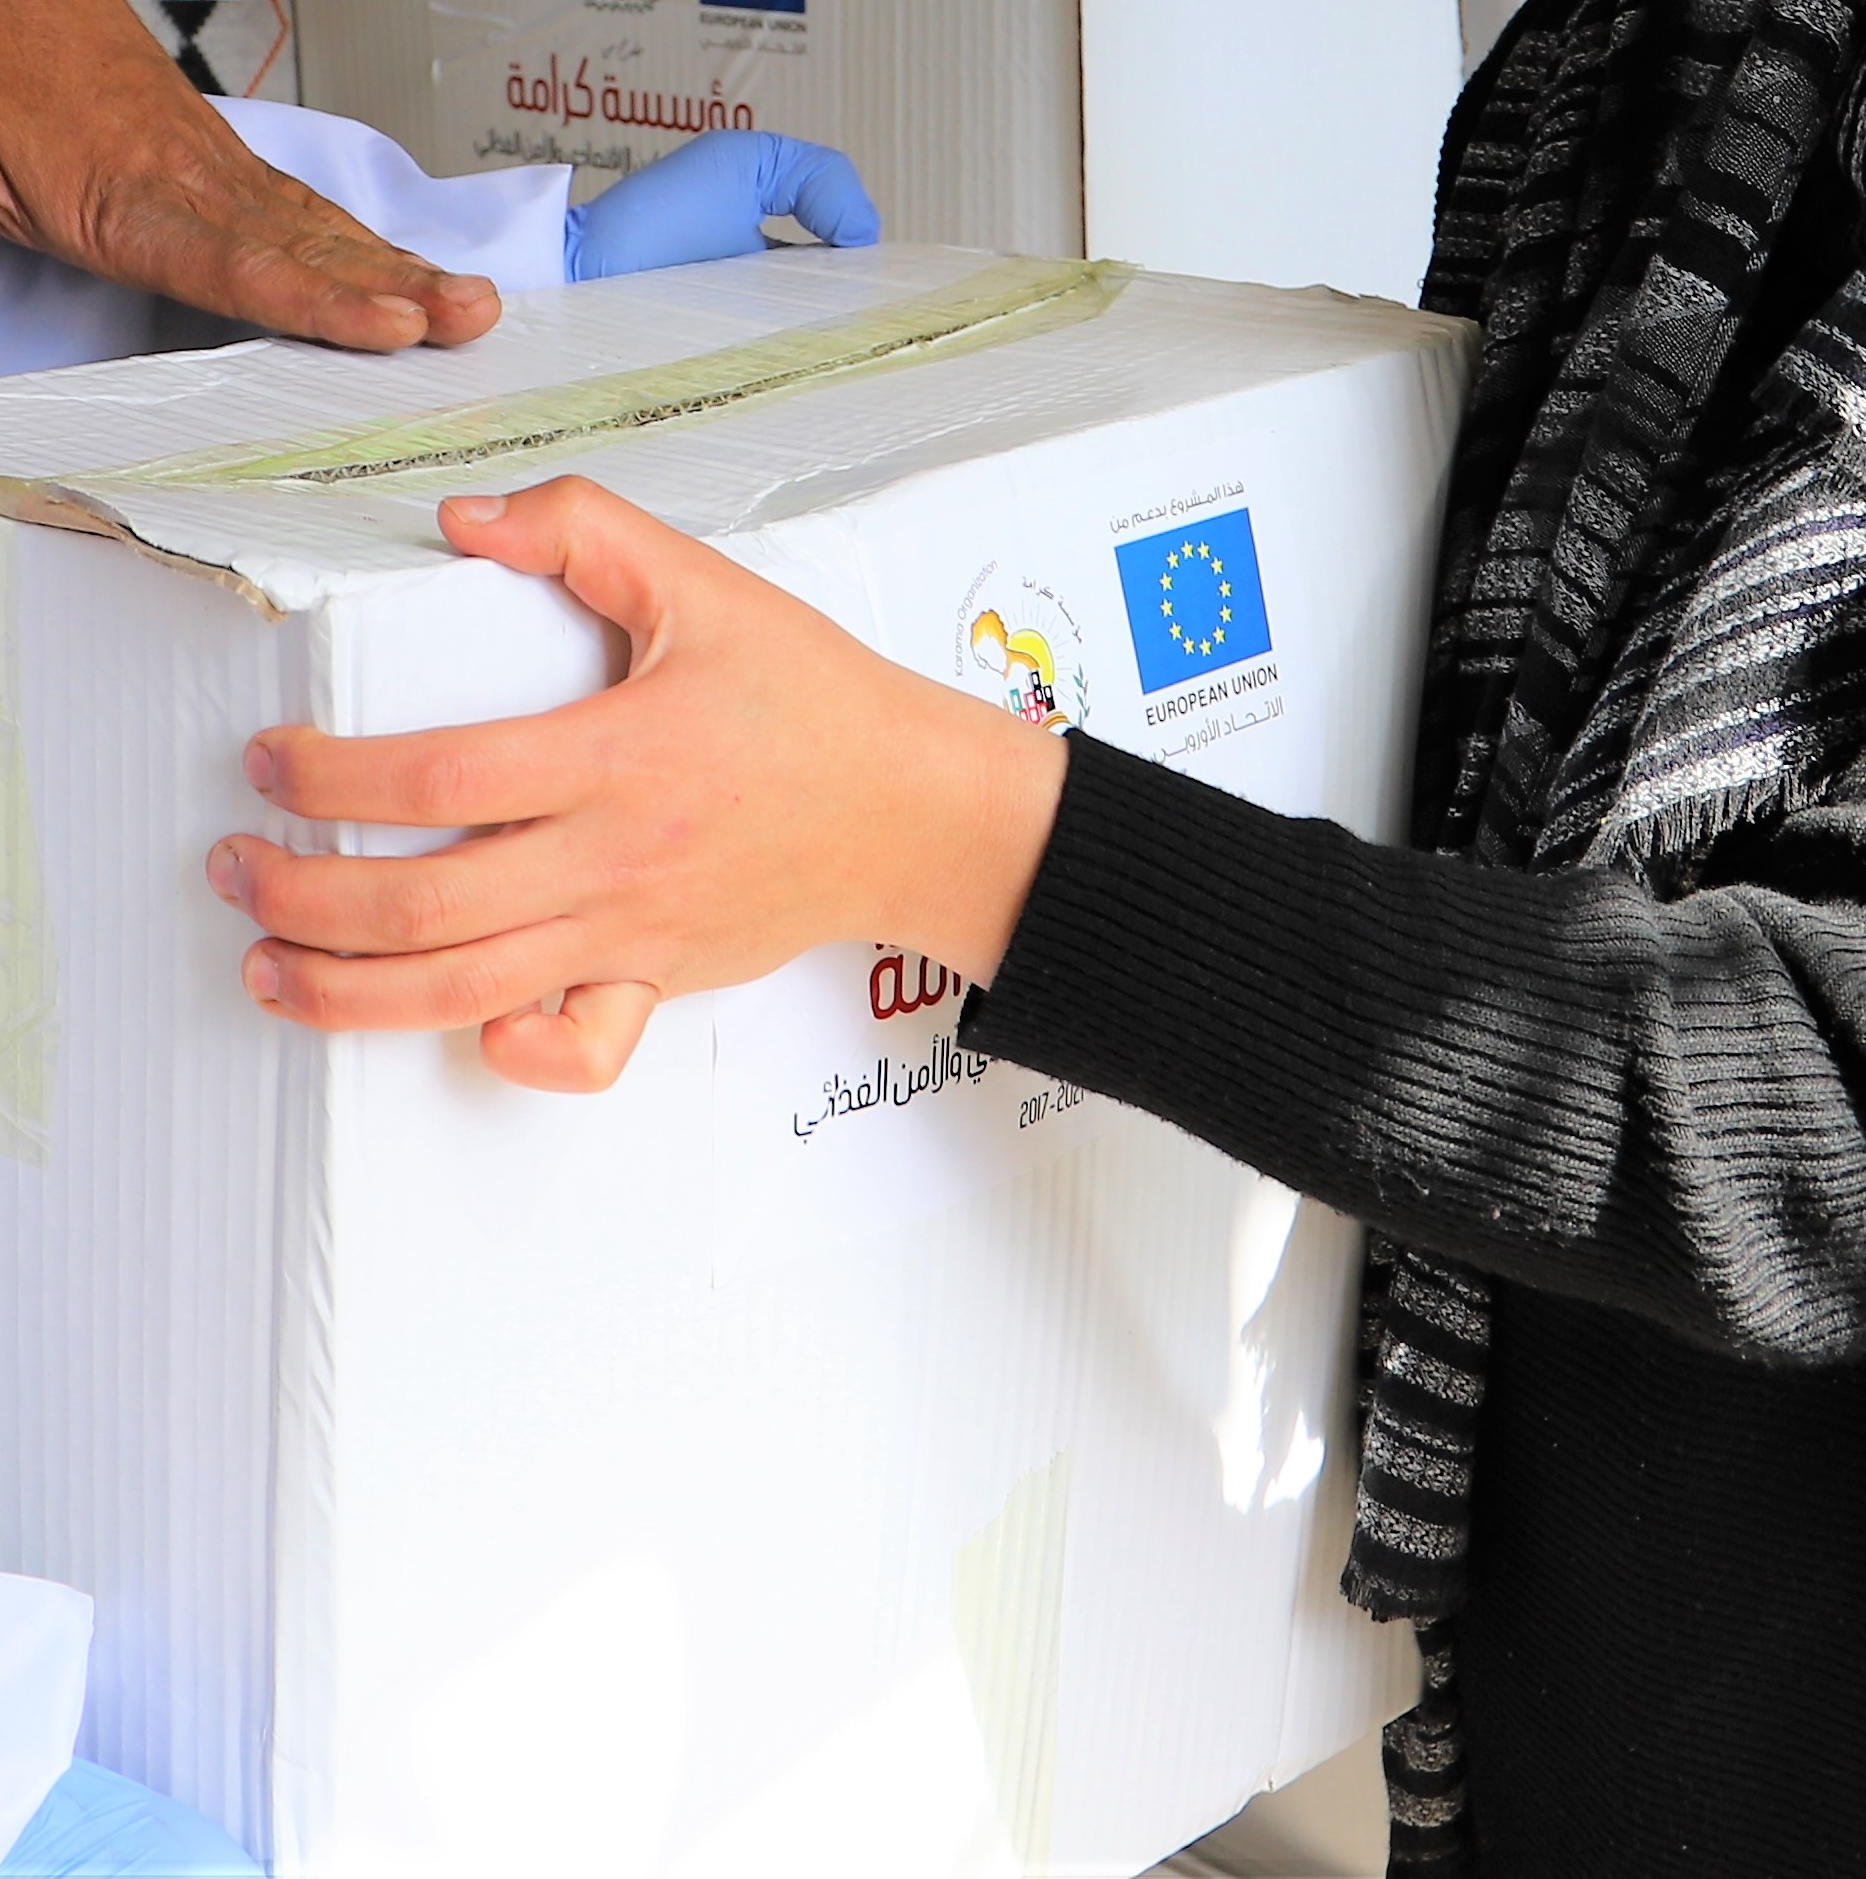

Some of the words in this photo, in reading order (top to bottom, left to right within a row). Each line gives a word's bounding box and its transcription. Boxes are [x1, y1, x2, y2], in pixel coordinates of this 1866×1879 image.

[506, 52, 594, 127] كرامة
[601, 74, 754, 131] مؤسسة
[1132, 505, 1168, 528] بدعم
[1170, 486, 1222, 516] المشروع
[1223, 480, 1245, 498] هذا
[1110, 515, 1130, 534] من
[957, 559, 999, 621] Organization
[954, 623, 964, 677] Karama
[1145, 680, 1229, 726] EUROPEAN
[1231, 663, 1279, 696] UNION
[892, 1033, 962, 1106] والأمن
